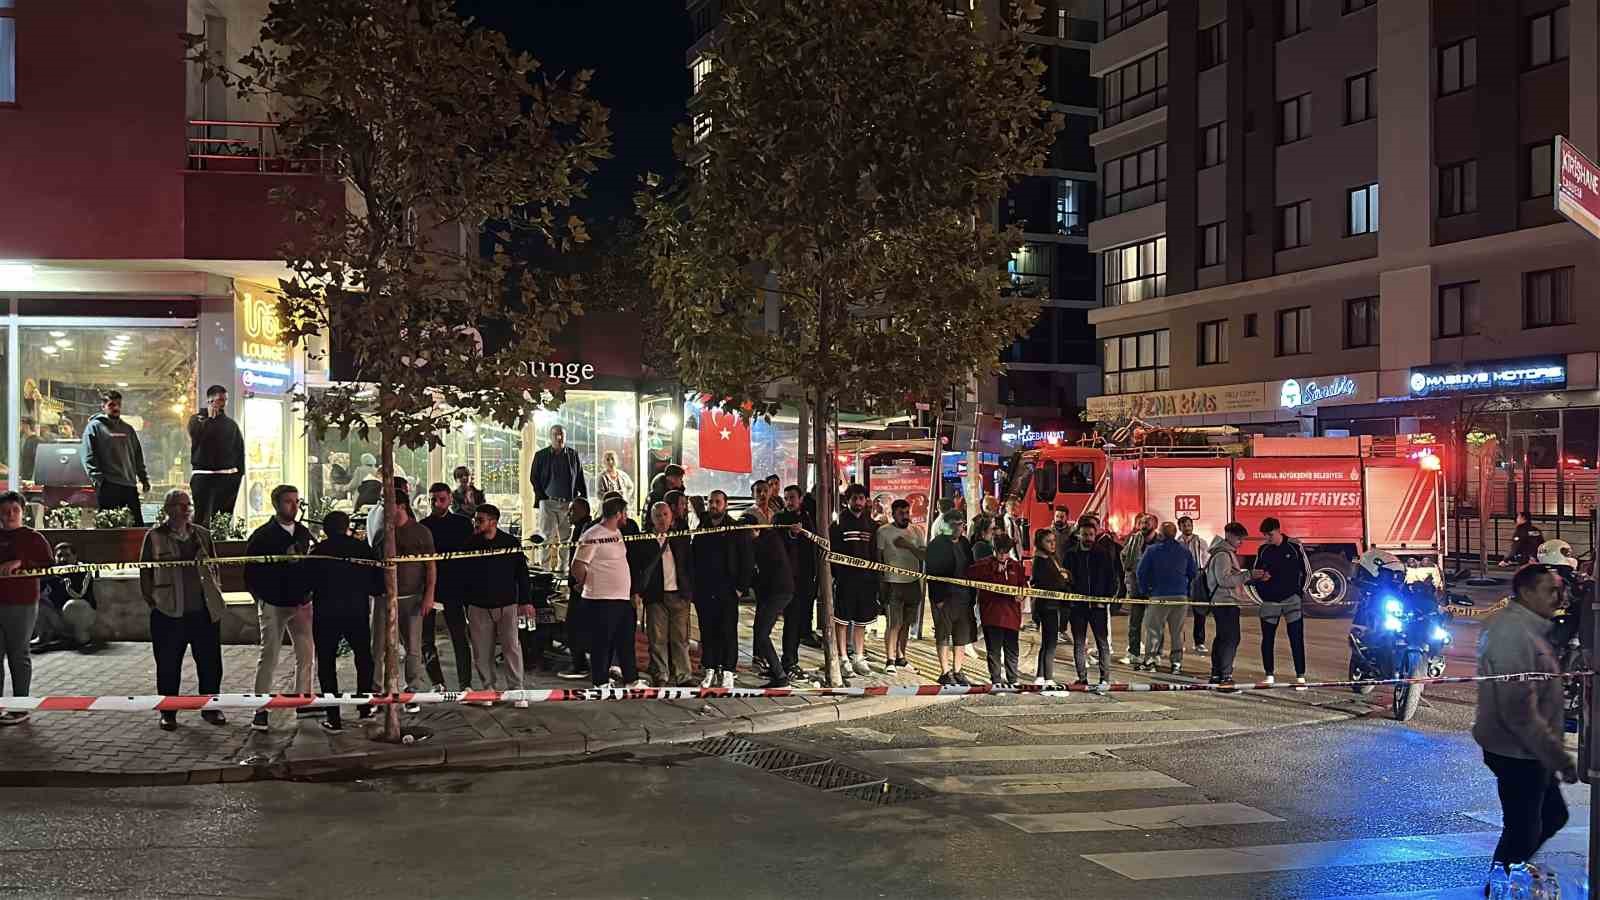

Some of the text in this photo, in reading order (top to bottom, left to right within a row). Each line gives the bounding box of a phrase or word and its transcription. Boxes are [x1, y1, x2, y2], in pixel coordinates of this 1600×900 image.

[243, 341, 287, 362] LOUNGE
[1493, 366, 1564, 381] MOTORS
[1252, 471, 1278, 480] İSTANBUL
[1313, 471, 1344, 480] BELEDİYESİ
[1178, 497, 1197, 510] 112
